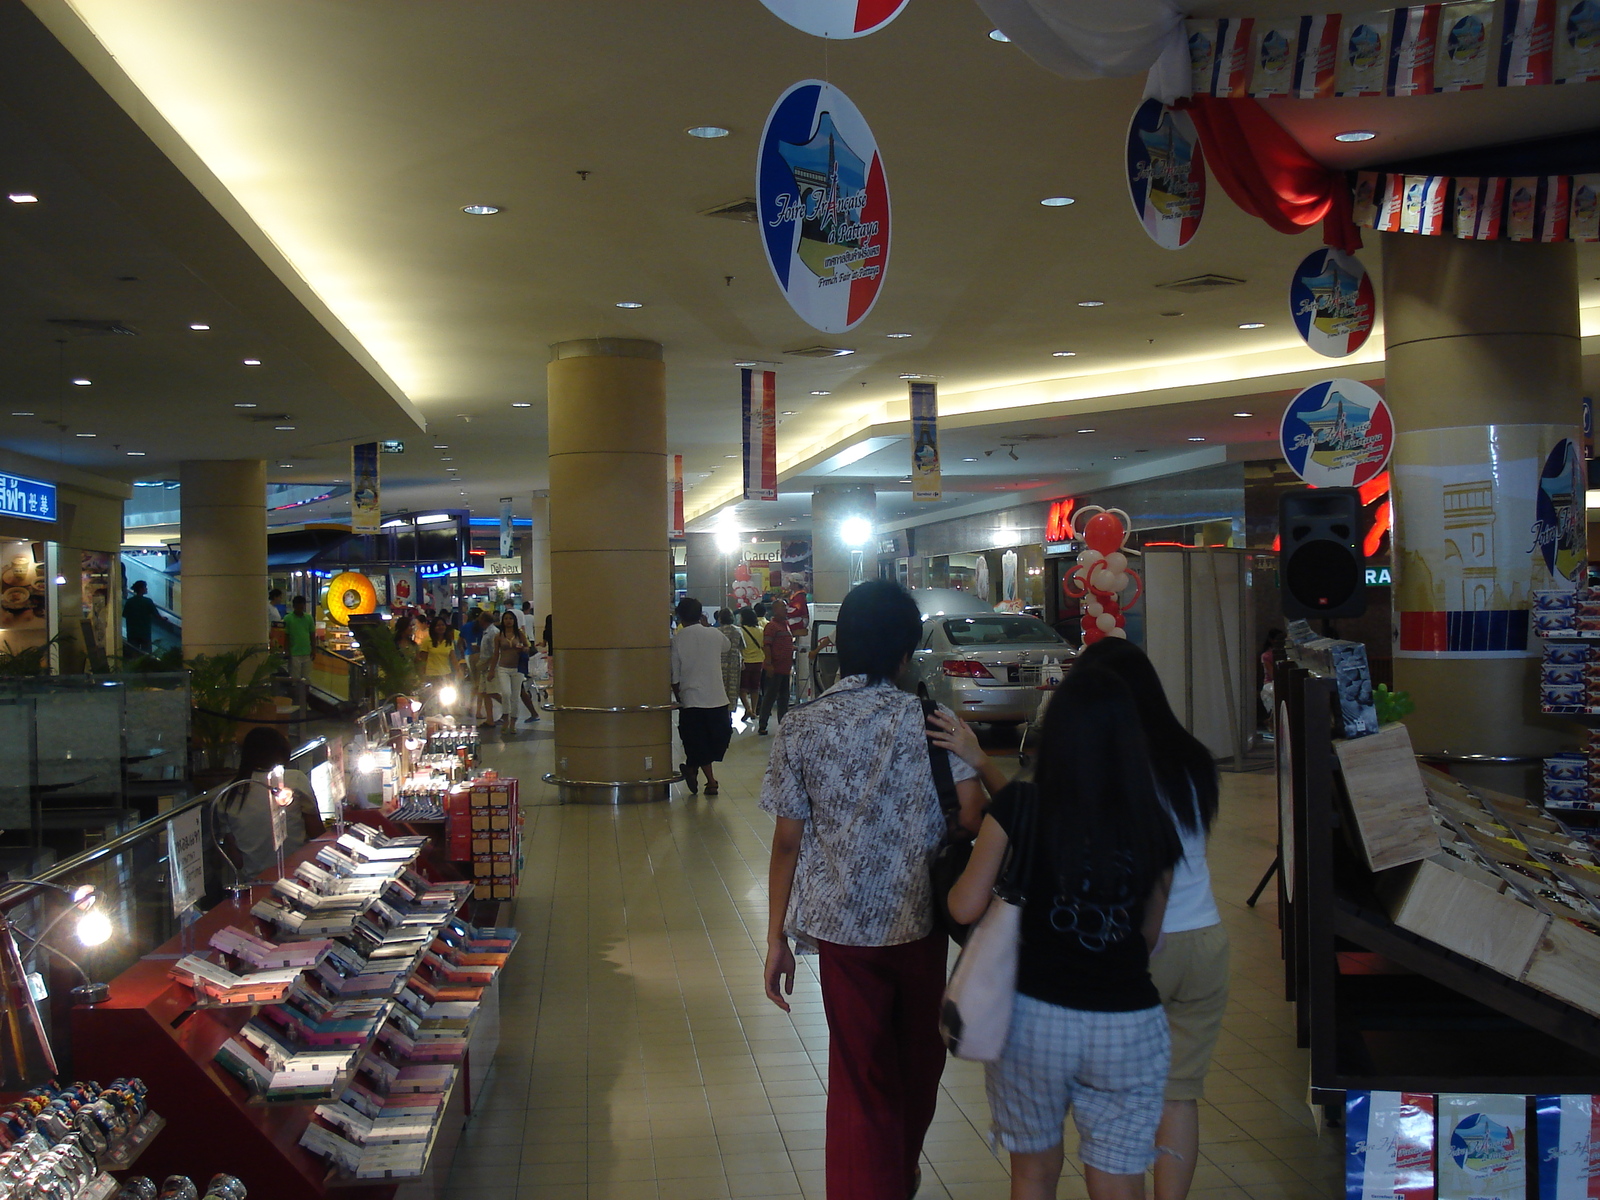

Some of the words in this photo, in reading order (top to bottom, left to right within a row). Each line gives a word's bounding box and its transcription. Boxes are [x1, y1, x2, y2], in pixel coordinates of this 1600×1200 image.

[837, 220, 880, 248] Pattaya
[818, 271, 838, 288] French
[838, 270, 852, 284] Fair
[858, 265, 881, 281] Pattaya
[744, 549, 782, 561] Carref
